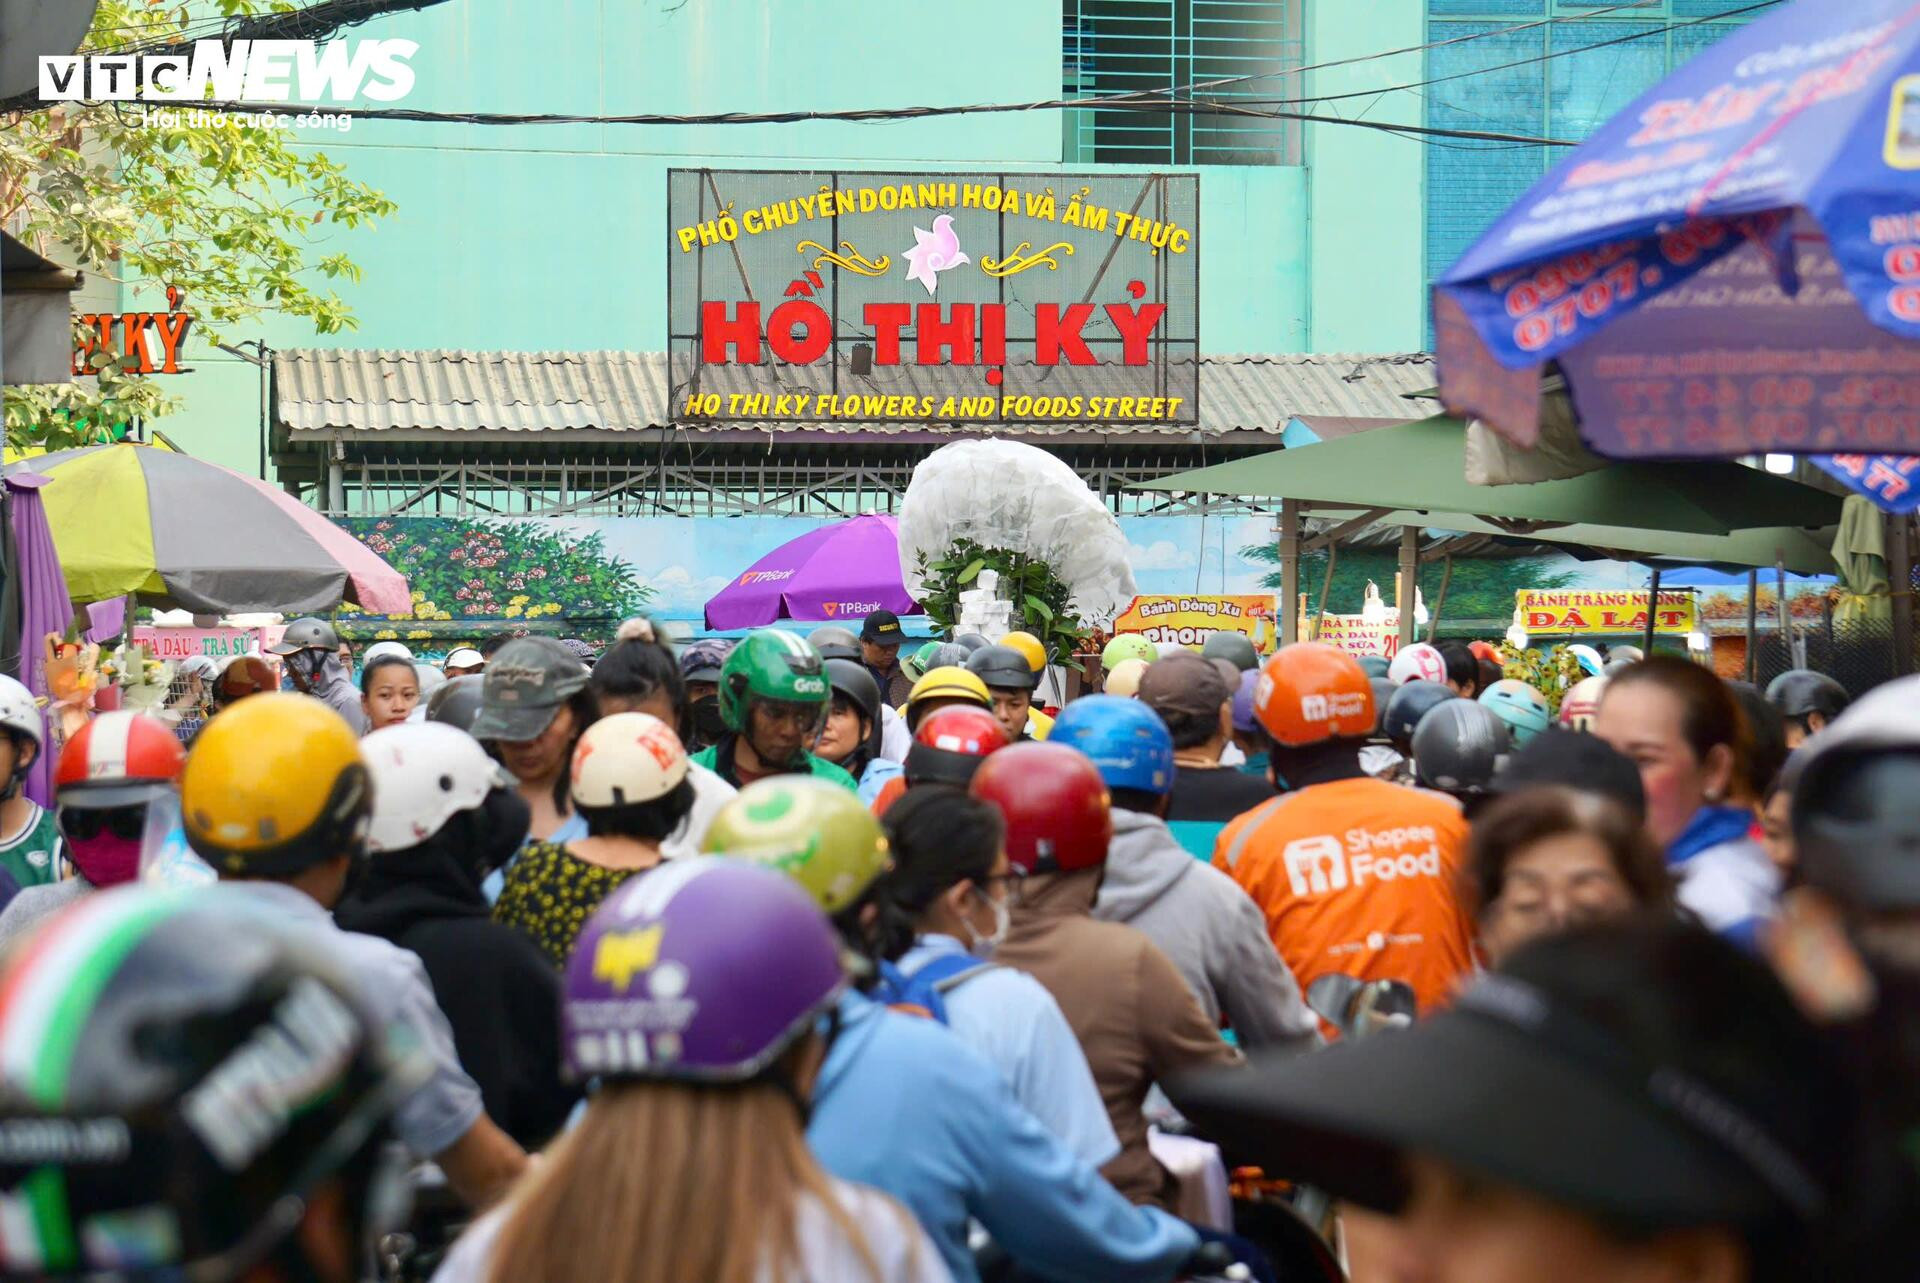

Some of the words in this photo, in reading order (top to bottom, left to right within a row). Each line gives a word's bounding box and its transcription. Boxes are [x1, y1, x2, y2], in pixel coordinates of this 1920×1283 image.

[676, 200, 738, 254] PHỐ
[742, 185, 855, 235] CHUYÊN
[859, 183, 957, 213] DOANH
[962, 183, 1020, 216] HOA
[1025, 187, 1055, 222] VÀ
[1061, 186, 1109, 232] ẨM
[1114, 211, 1190, 257] THỰC
[701, 271, 832, 365] HỒ
[863, 303, 1006, 387] THỊ
[1035, 279, 1168, 366] KỶ
[684, 393, 721, 416] HO
[728, 393, 770, 416] THI
[773, 394, 811, 416] KY
[815, 394, 936, 417] FLOWERS
[938, 395, 997, 418] AND
[1000, 395, 1083, 418] FOODS
[1086, 396, 1184, 418] STREET
[752, 568, 796, 584] TPBank
[839, 601, 881, 615] TPBank
[1139, 600, 1177, 618] Bánh
[1219, 601, 1242, 617] Xu
[1601, 610, 1688, 631] LẠT
[202, 632, 229, 656] TRÀ
[233, 631, 257, 656] SỮ
[794, 678, 824, 693] Grab
[1345, 826, 1436, 850] Shopee
[1351, 845, 1440, 887] Food
